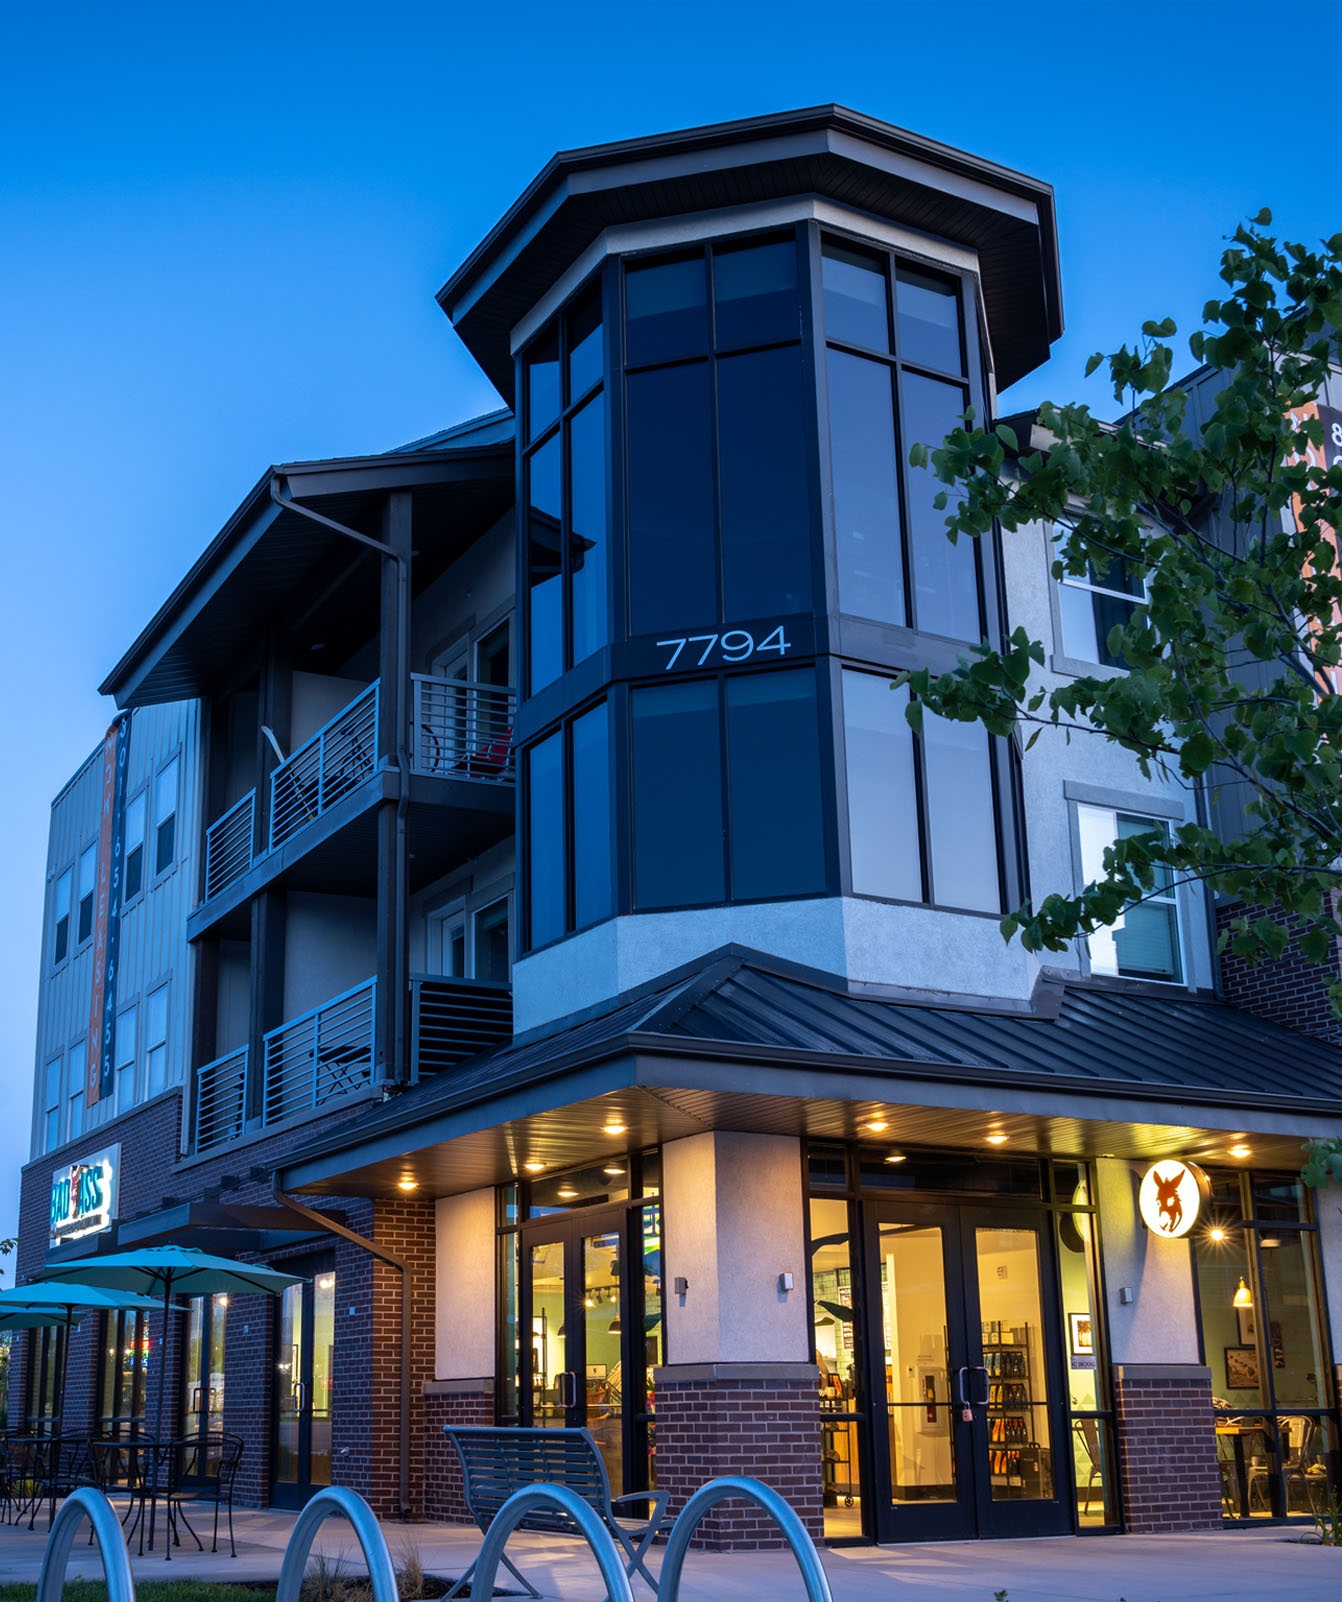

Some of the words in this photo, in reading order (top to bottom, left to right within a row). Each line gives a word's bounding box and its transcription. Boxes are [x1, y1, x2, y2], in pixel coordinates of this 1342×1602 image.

[656, 625, 791, 670] 7794
[89, 863, 107, 1087] LEASING
[49, 1179, 71, 1225] BAD
[77, 1165, 104, 1215] ASS
